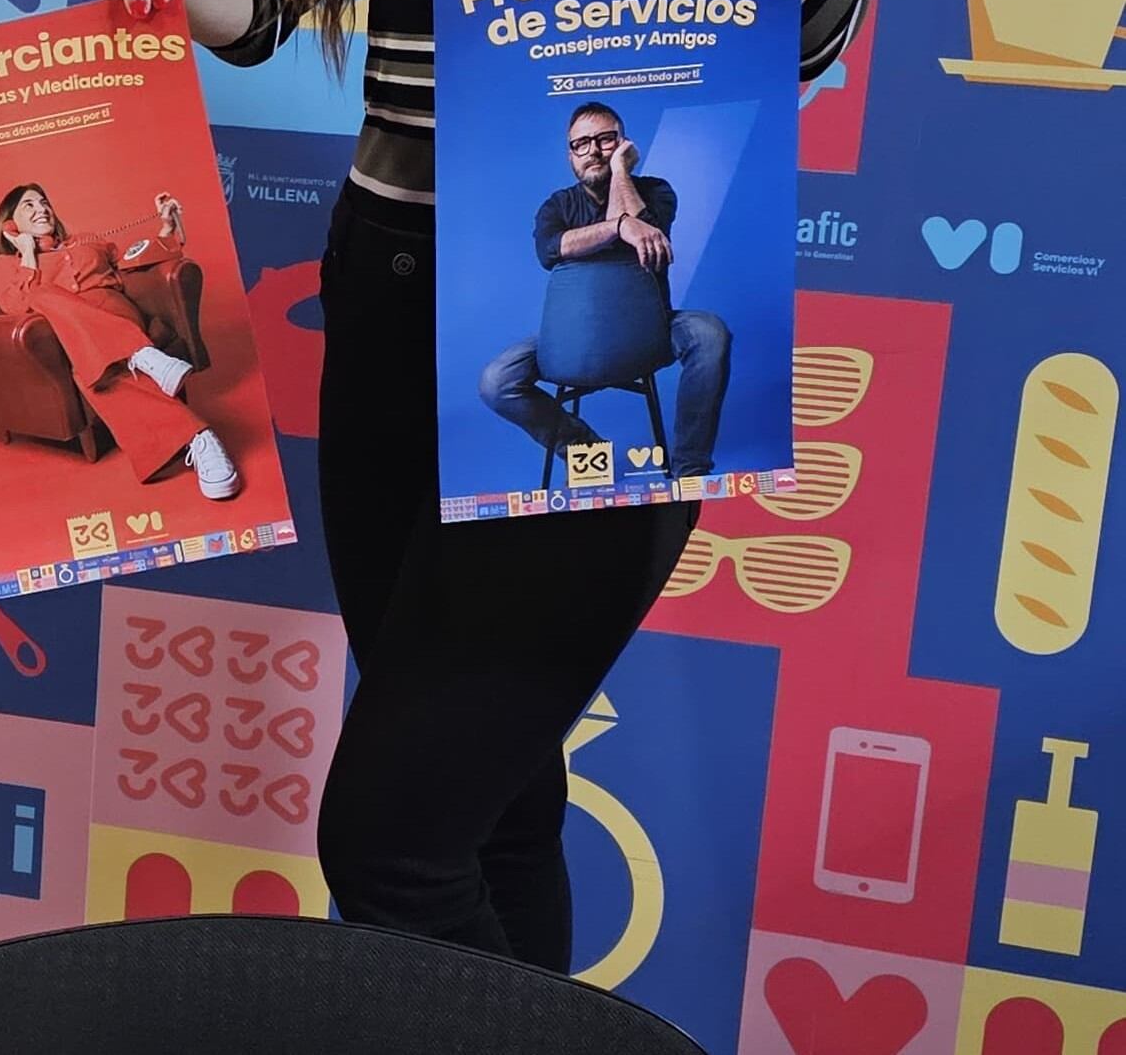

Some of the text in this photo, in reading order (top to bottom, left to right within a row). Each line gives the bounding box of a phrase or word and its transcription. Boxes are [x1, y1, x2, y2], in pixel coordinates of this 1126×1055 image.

[487, 8, 547, 46] de
[530, 29, 717, 59] Consejeros y Amigos
[19, 86, 31, 105] y
[33, 72, 144, 97] Mediadores
[576, 76, 602, 88] años
[604, 74, 647, 86] dándolo
[648, 71, 672, 82] todo
[673, 71, 691, 82] por
[692, 68, 701, 78] ti
[12, 121, 56, 137] dándolo
[57, 115, 81, 128] todo
[82, 112, 100, 124] por
[102, 108, 110, 118] ti
[247, 185, 320, 205] VILLENA
[796, 211, 858, 247] afic
[1033, 262, 1084, 275] Servicios
[1034, 251, 1106, 268] Comercios y
